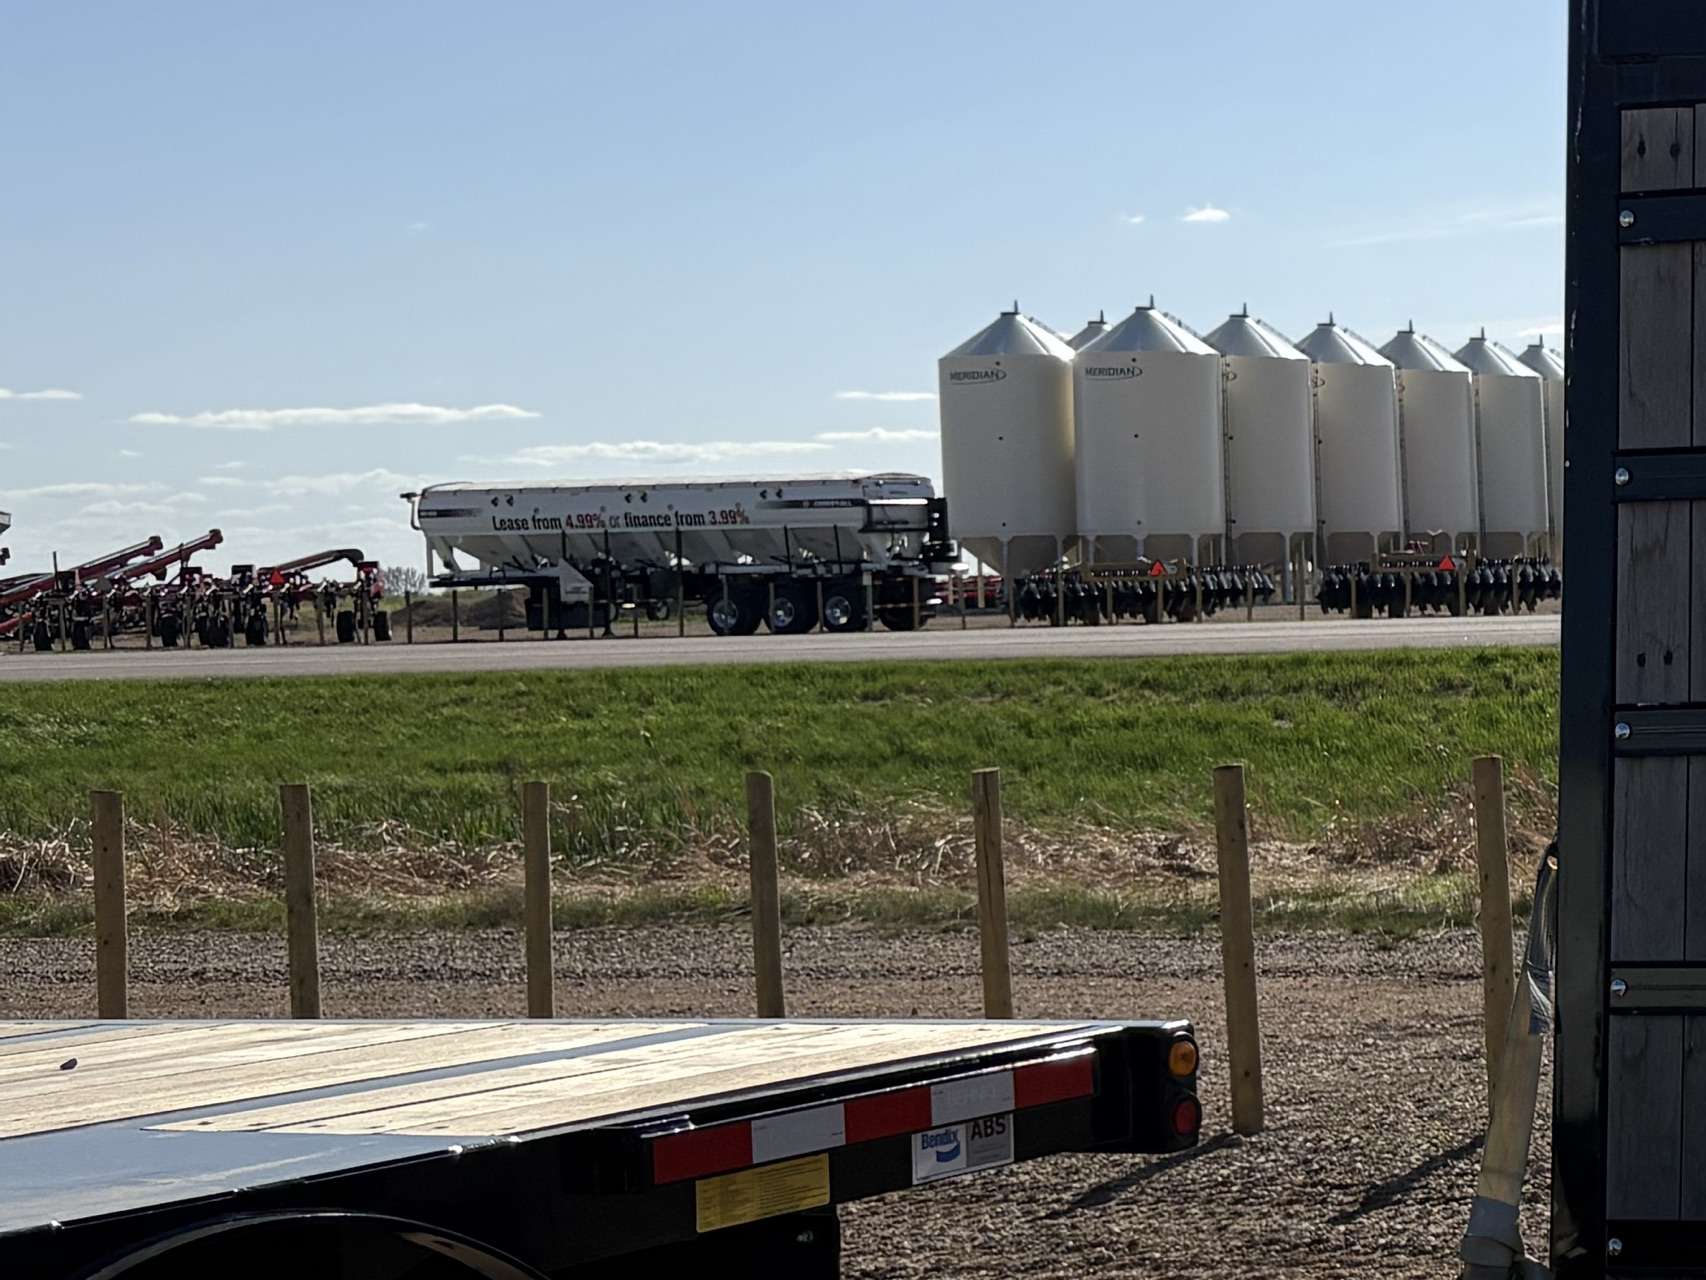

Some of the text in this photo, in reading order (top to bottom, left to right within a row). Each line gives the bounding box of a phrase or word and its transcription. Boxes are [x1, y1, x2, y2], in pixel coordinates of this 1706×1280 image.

[950, 370, 1000, 381] MERIDIAN
[1085, 367, 1136, 377] MERIDIAN
[492, 507, 750, 531] Lease from 4.99% or finance from 3.99%
[921, 1128, 961, 1150] Bendix
[971, 1116, 1006, 1141] ABS
